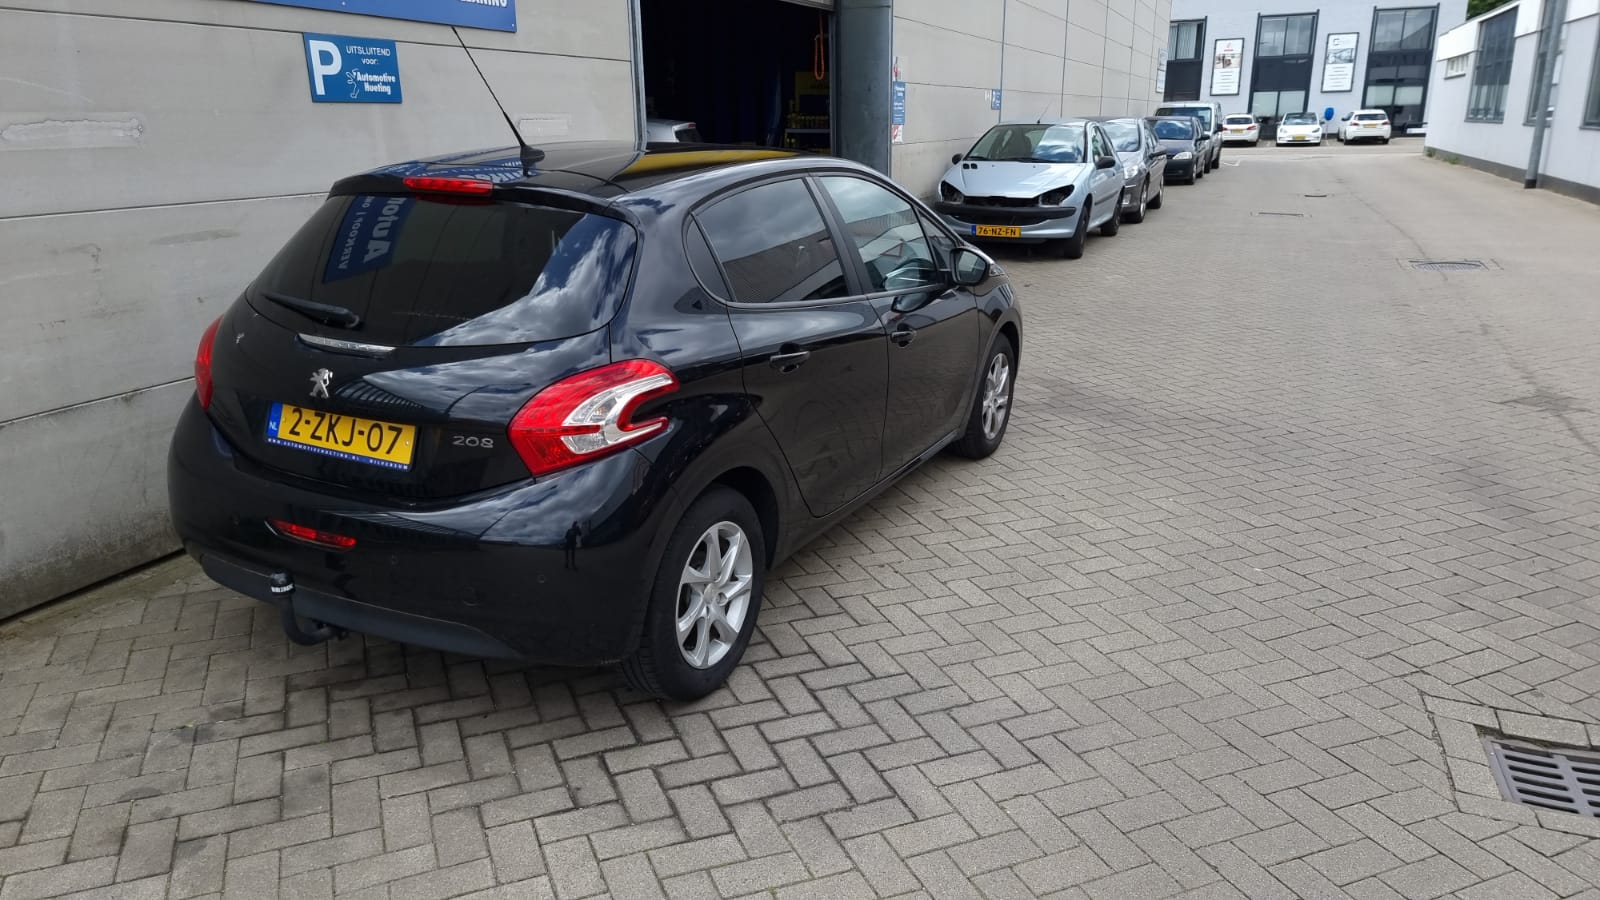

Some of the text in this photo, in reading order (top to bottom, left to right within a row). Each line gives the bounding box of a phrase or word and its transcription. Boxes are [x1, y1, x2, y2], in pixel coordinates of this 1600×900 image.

[346, 45, 391, 56] UITSLUITEND
[309, 40, 342, 95] P
[356, 71, 396, 83] Automotive
[363, 81, 391, 95] Hueting
[978, 227, 1016, 236] 76-NZ-FN
[269, 420, 278, 431] NL
[288, 407, 403, 455] 2-ZKJ-07
[452, 435, 495, 448] 208
